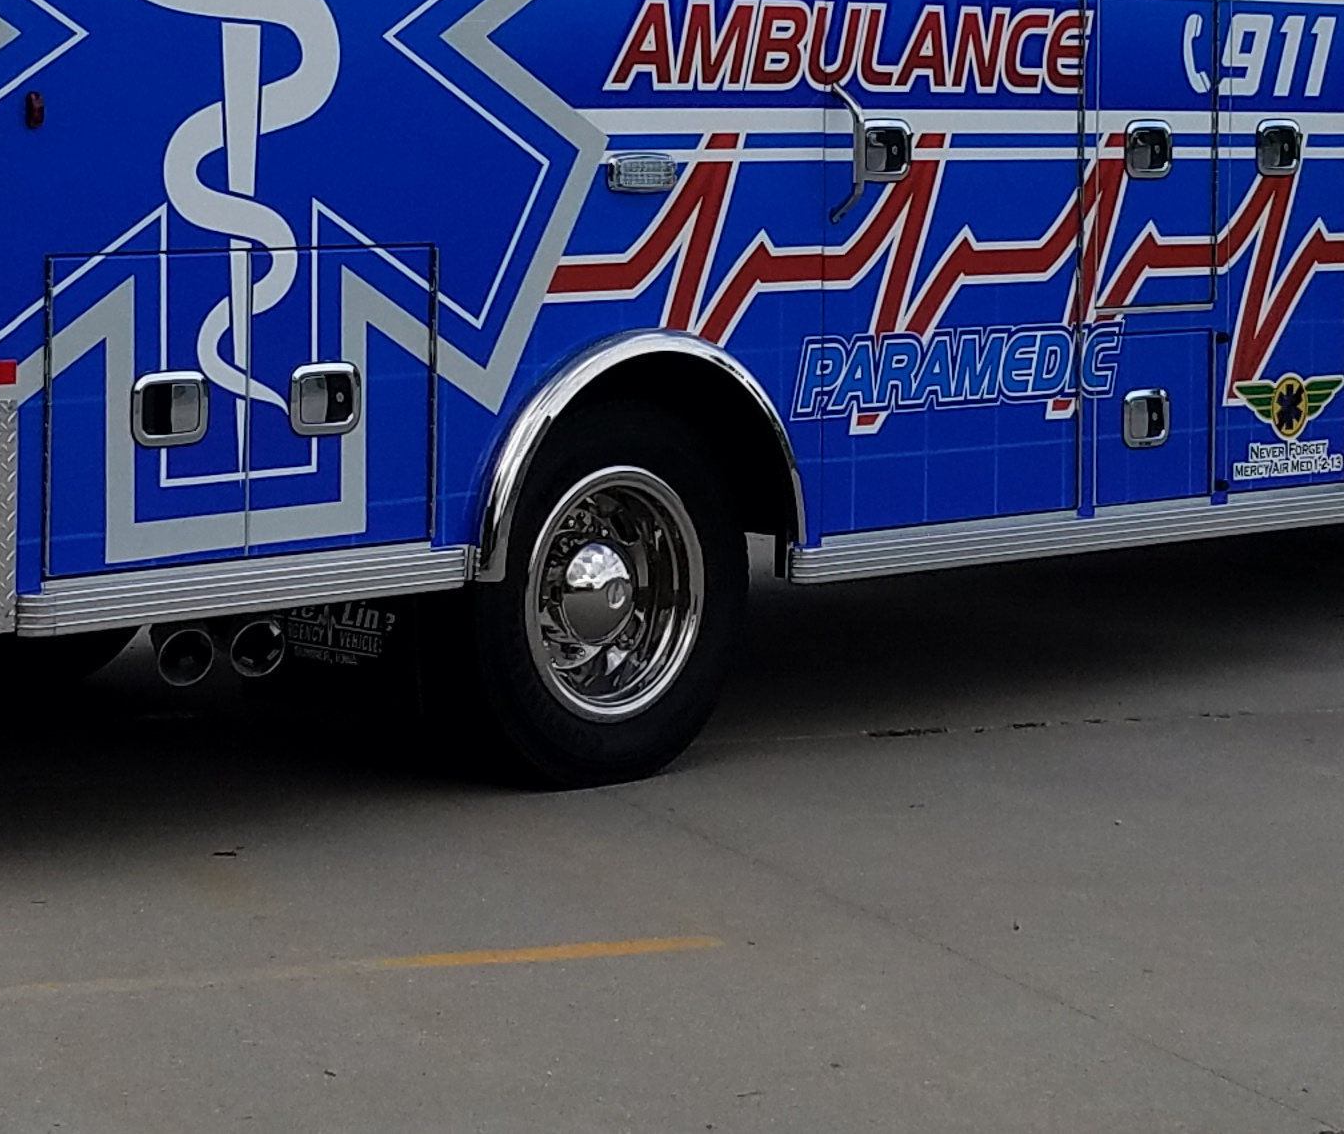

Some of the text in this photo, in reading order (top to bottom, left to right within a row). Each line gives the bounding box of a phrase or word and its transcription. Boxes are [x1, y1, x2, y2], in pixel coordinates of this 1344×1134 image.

[1217, 13, 1337, 98] 911
[790, 320, 1126, 422] PARAMEDIC
[1234, 464, 1270, 478] MERCY
[1272, 460, 1289, 474] AIR
[1291, 459, 1313, 473] MED
[1250, 442, 1327, 460] NEVER FORGET
